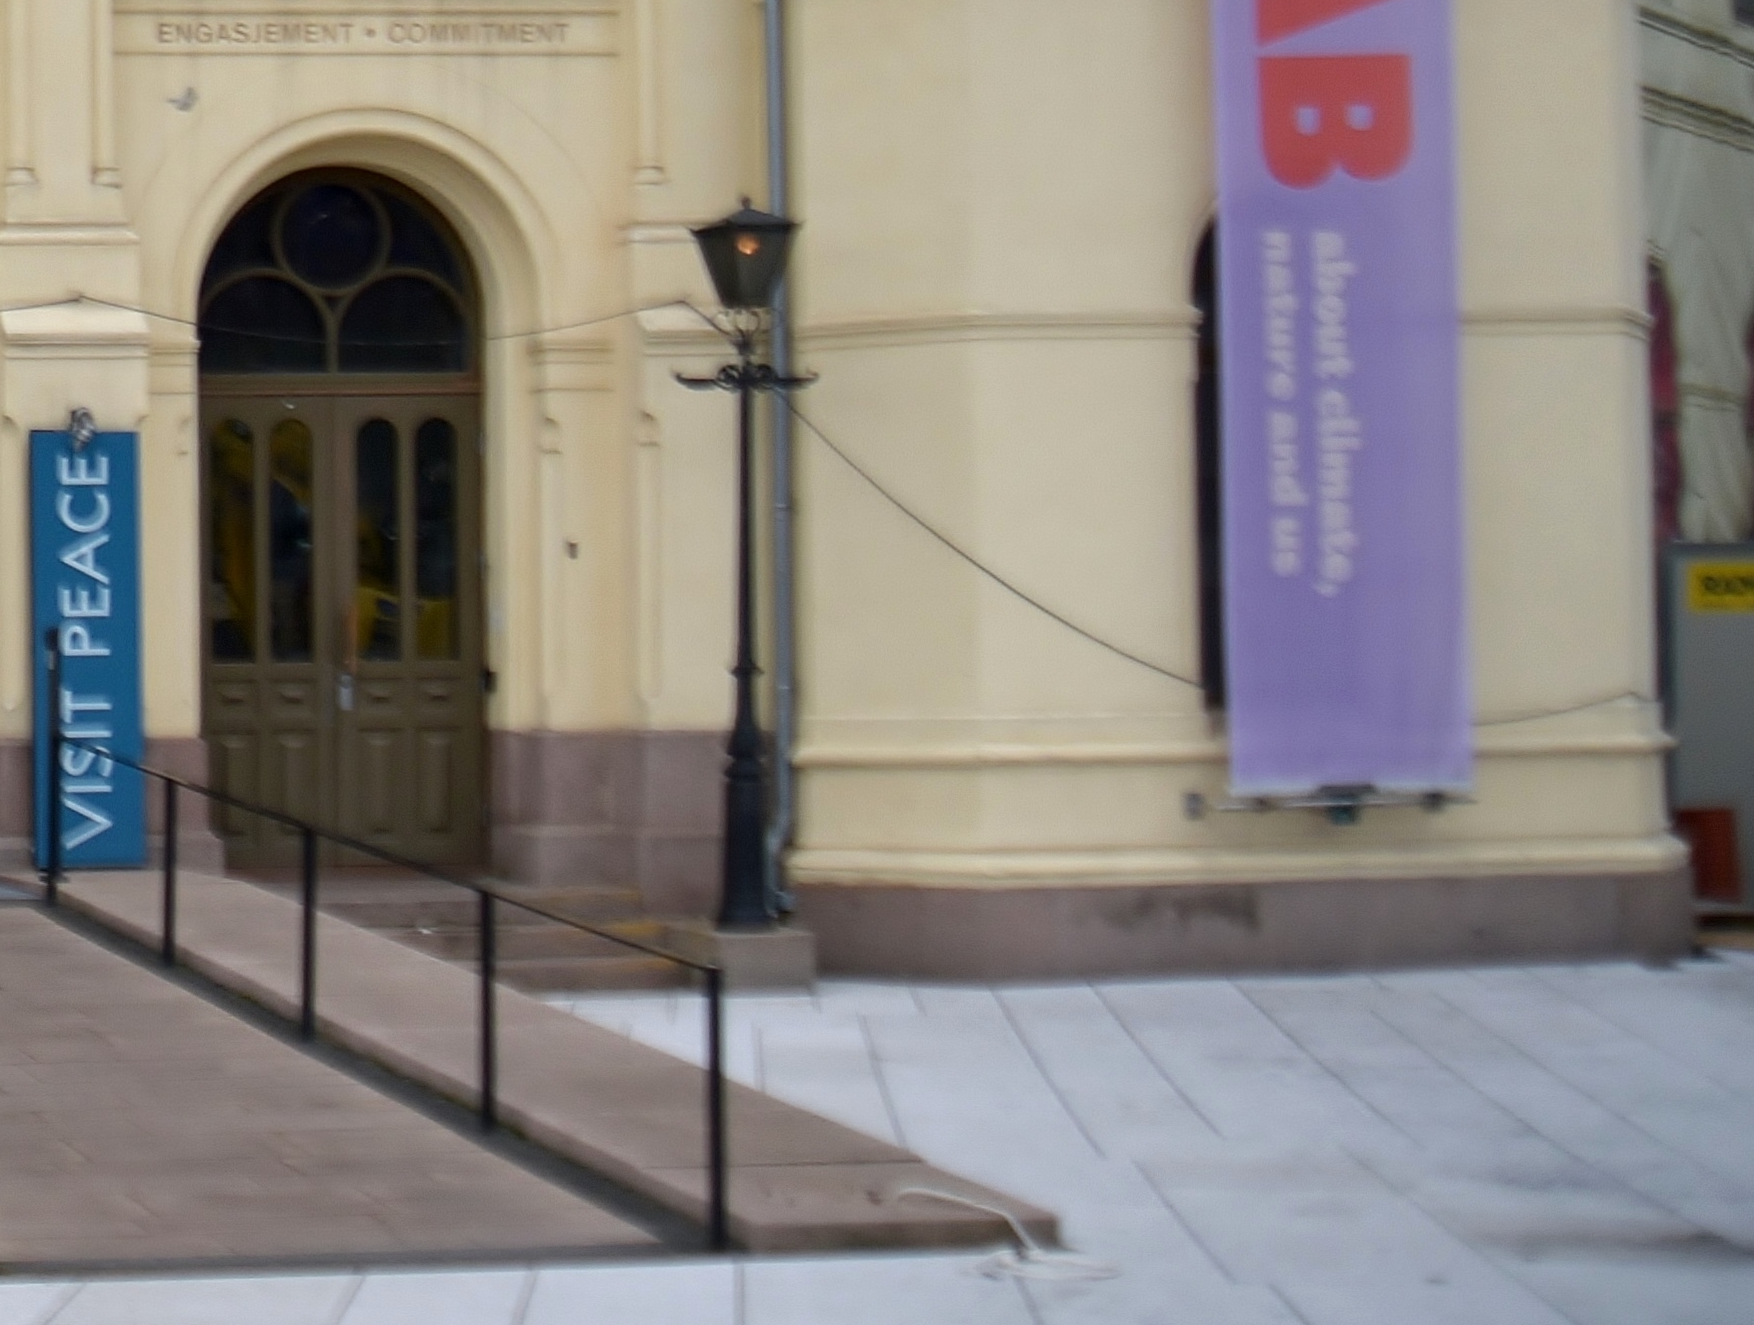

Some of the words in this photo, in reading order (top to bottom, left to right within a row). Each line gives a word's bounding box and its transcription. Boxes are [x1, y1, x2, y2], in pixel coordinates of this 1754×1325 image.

[157, 22, 355, 45] ENGASJEMENT
[387, 22, 570, 45] COMMITMENT
[1262, 230, 1300, 400] nature
[1312, 230, 1359, 381] about
[1268, 411, 1309, 506] and
[1314, 389, 1363, 598] climate,
[56, 454, 112, 657] PEACE
[1271, 517, 1302, 577] us
[59, 688, 114, 851] VISIT
